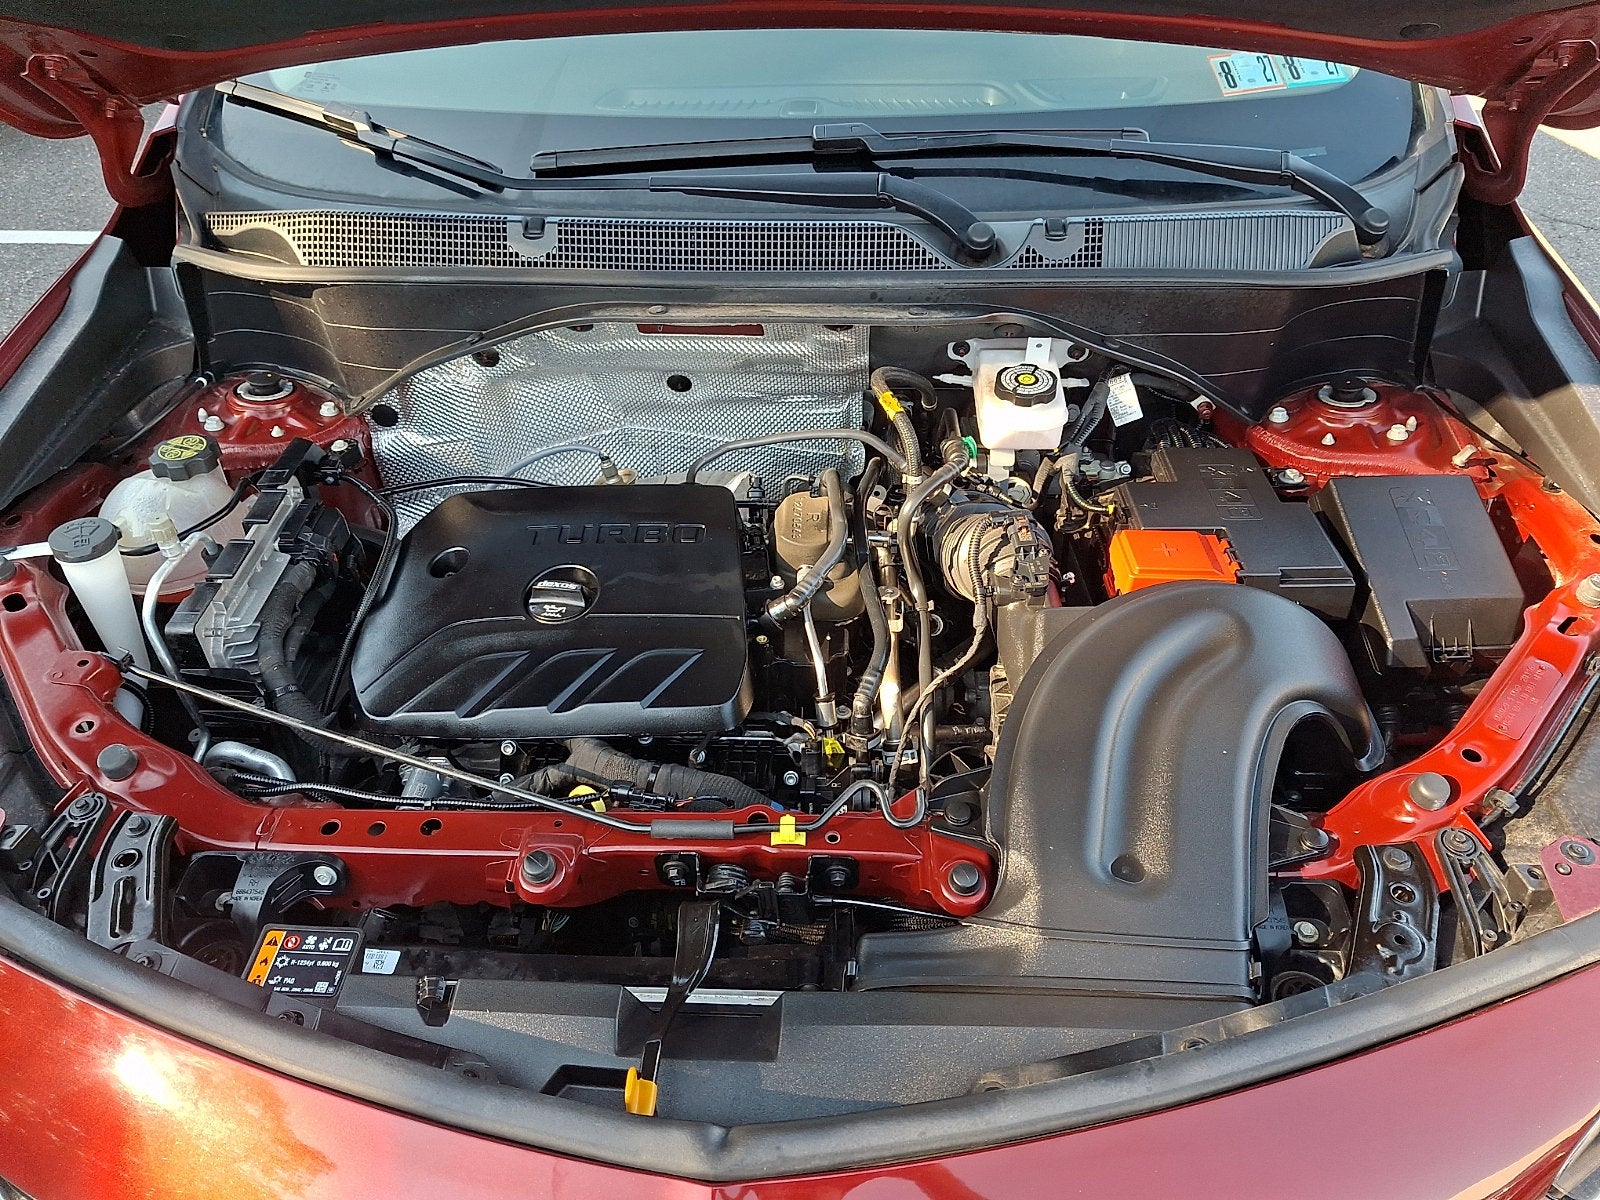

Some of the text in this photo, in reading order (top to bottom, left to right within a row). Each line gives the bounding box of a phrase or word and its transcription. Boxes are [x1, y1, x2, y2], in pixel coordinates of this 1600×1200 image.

[1219, 60, 1238, 89] 8
[1256, 55, 1278, 83] 27
[1283, 55, 1301, 80] 8
[526, 523, 706, 545] TURBO
[537, 579, 579, 590] dexos
[282, 977, 296, 985] PAG
